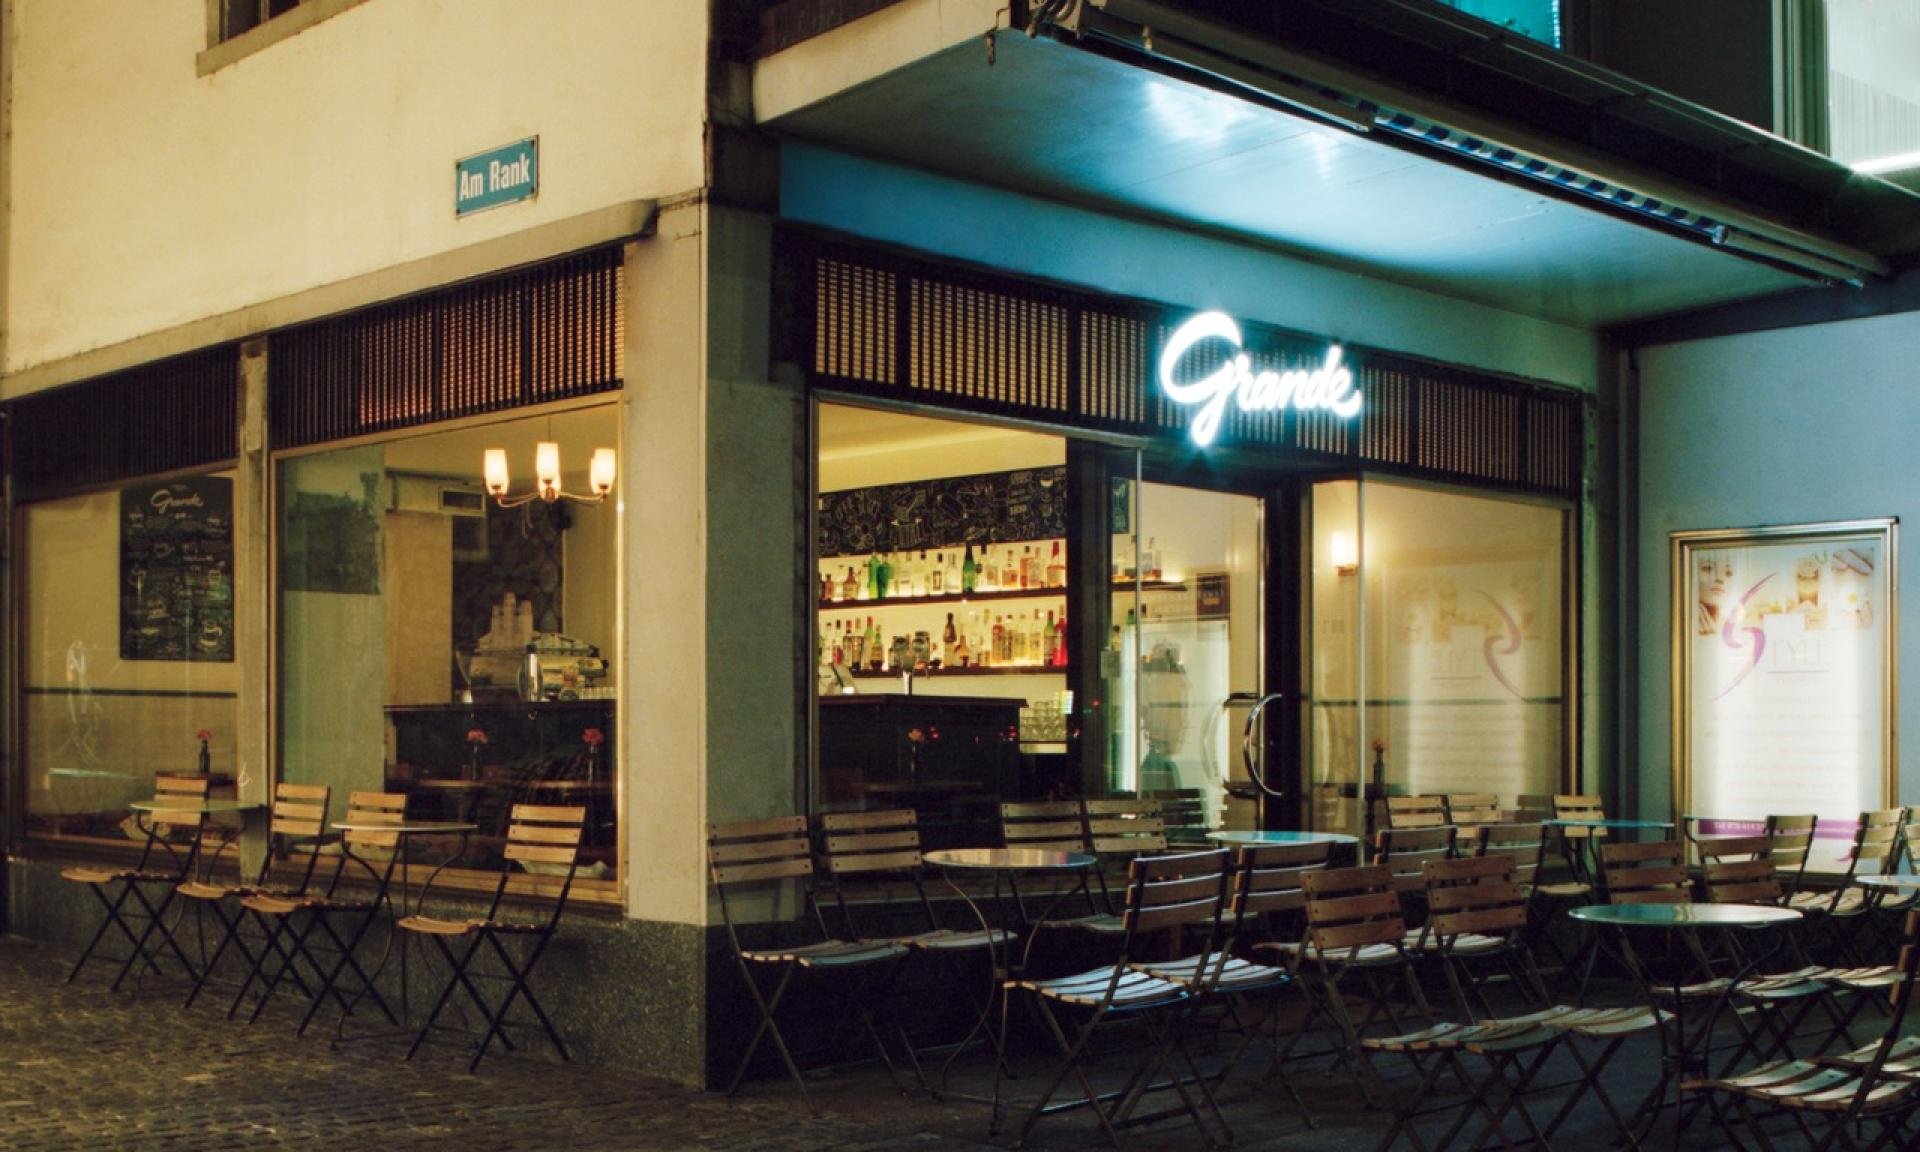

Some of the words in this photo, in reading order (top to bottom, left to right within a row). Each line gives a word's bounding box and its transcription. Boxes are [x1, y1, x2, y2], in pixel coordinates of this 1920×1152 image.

[459, 170, 484, 201] Am
[489, 153, 530, 192] Rank
[1160, 310, 1363, 447] Grande
